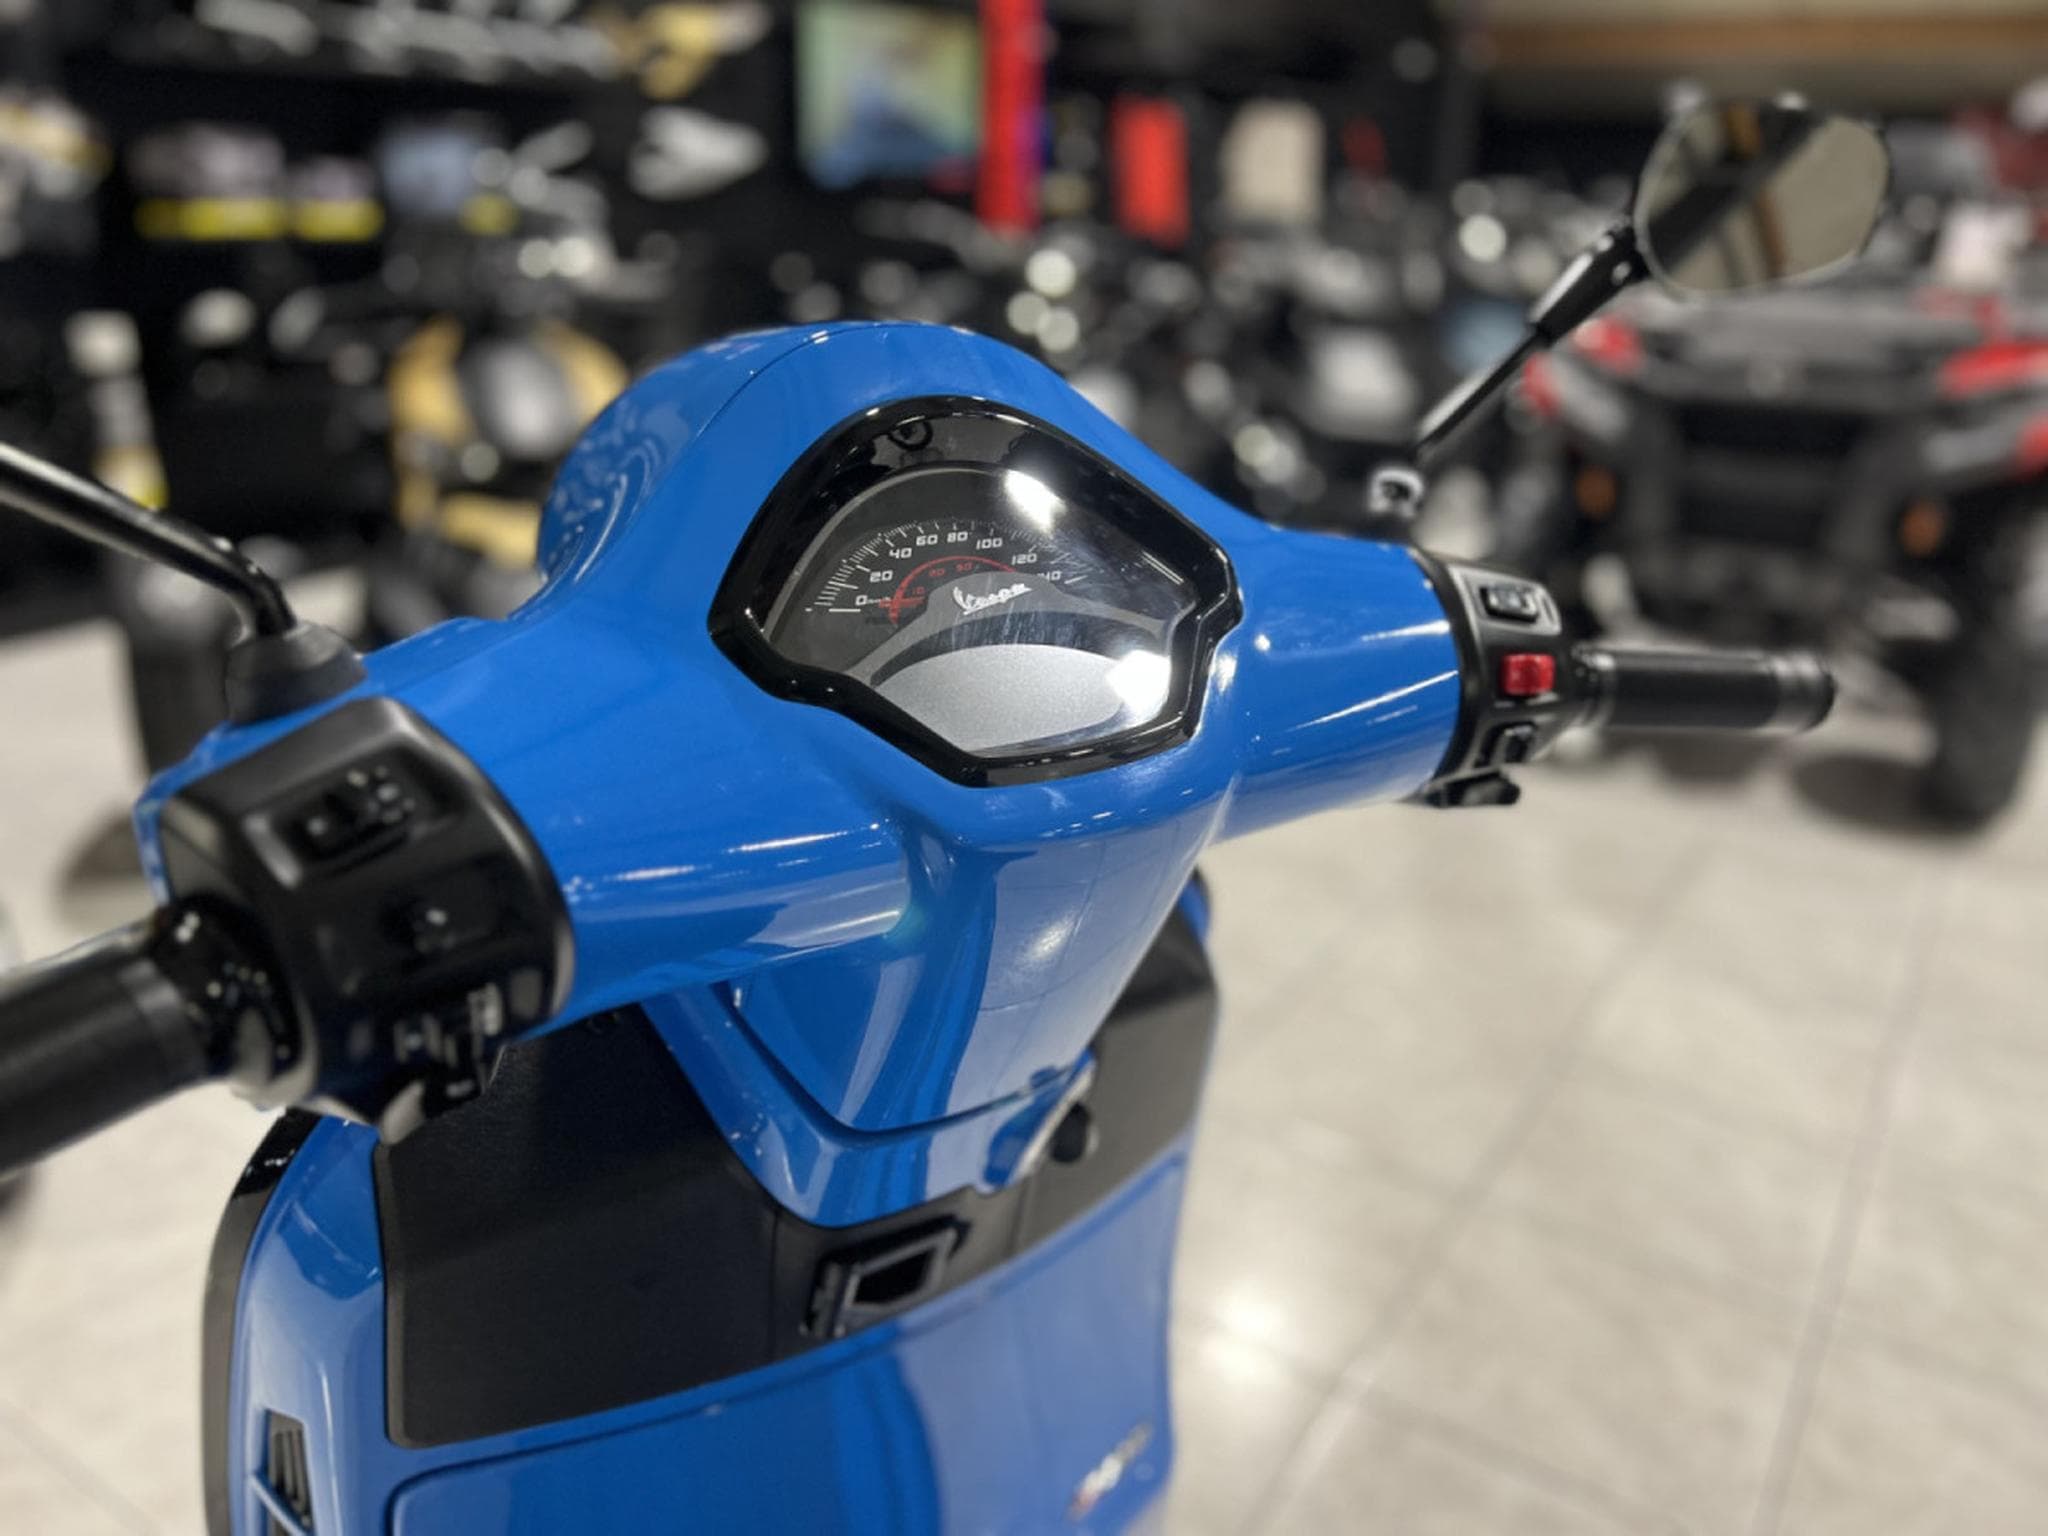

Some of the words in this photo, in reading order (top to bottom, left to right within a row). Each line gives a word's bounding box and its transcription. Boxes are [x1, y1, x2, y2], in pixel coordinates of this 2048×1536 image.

[855, 595, 868, 606] 0
[869, 570, 893, 582] 20
[889, 547, 912, 559] 40
[916, 534, 938, 546] 60
[947, 531, 968, 543] 80
[976, 538, 1003, 550] 100
[1011, 553, 1037, 565] 120
